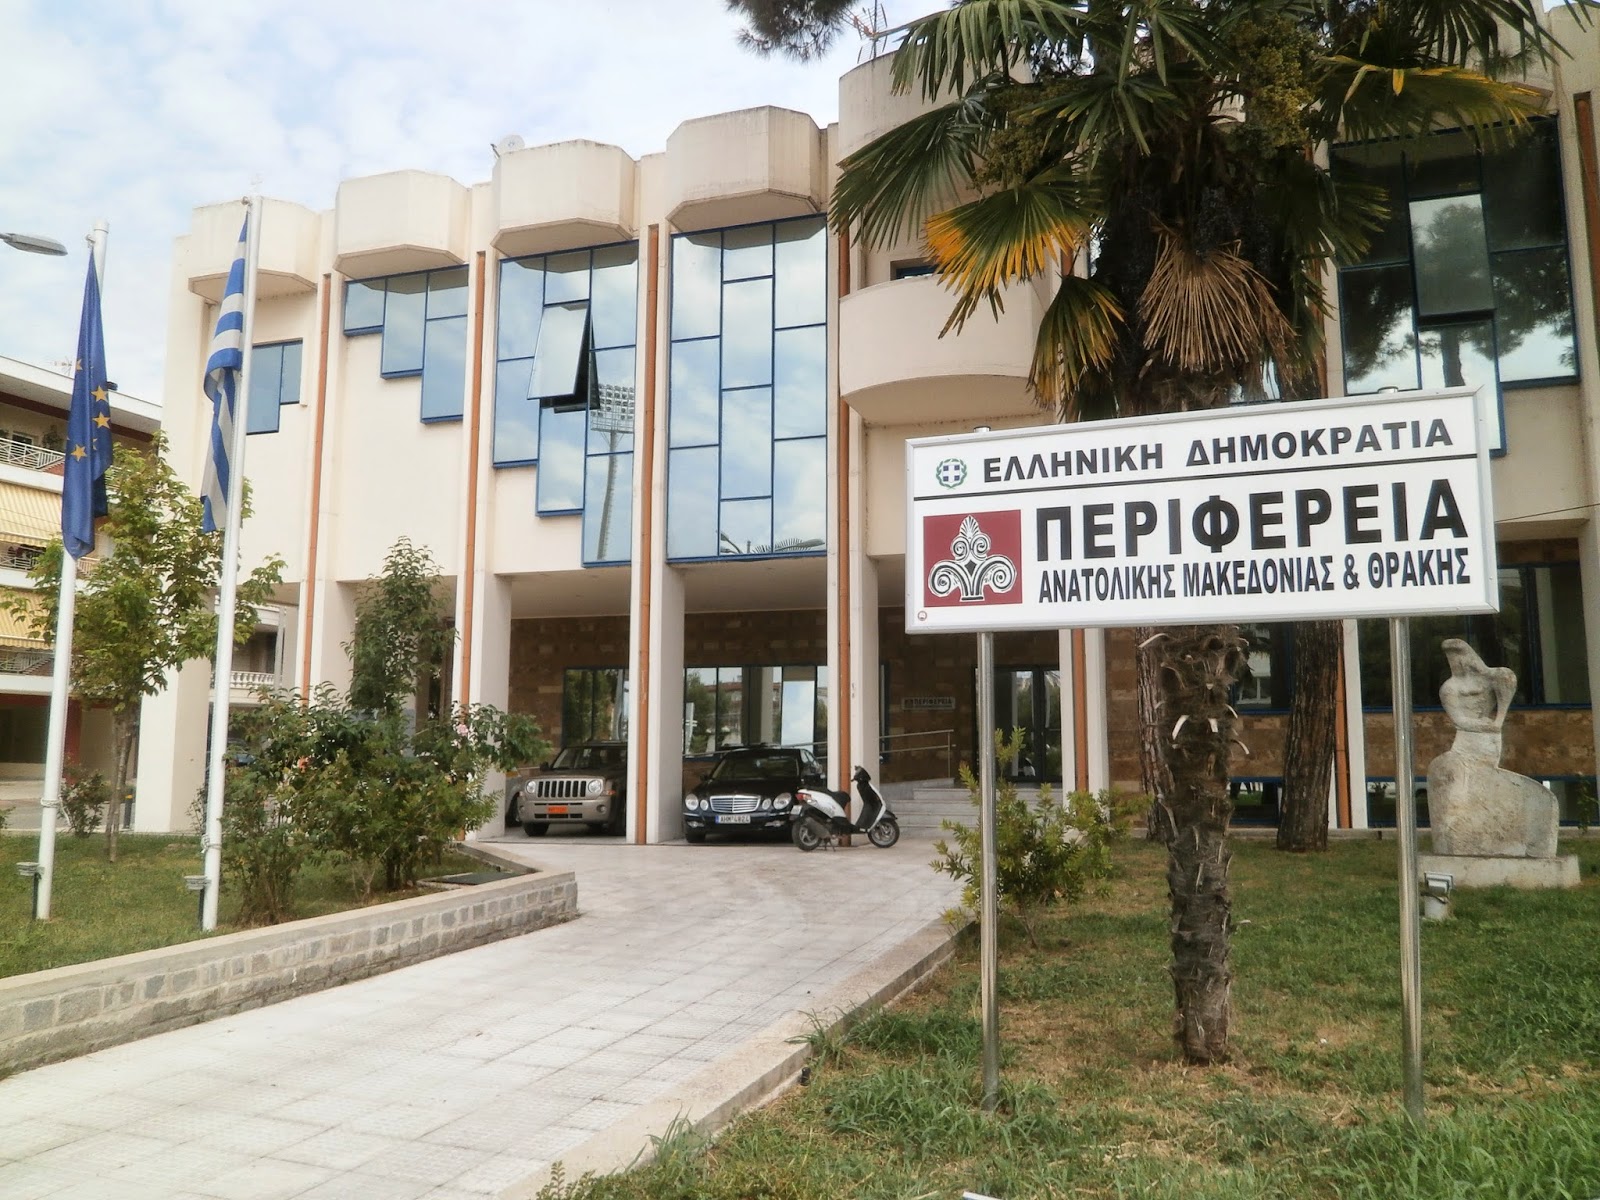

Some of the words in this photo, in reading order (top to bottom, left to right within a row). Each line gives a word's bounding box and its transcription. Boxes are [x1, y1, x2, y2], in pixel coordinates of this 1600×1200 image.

[983, 443, 1163, 483] ΕΛΛΗΝΙΚΗ
[1185, 418, 1453, 467] ΔΗΜΟΚΡΑΤΙΑ
[1036, 478, 1469, 562] ΠΕΡΙΦΕΡΕΙΑ
[1038, 564, 1176, 604] ΑΝΑΤΟΛΙΚΗΣ
[1183, 555, 1335, 598] ΜΑΚΕΔΟΝΙΑΣ
[1343, 553, 1360, 590] &
[1367, 547, 1471, 589] ΘΡΑΚΗΣ
